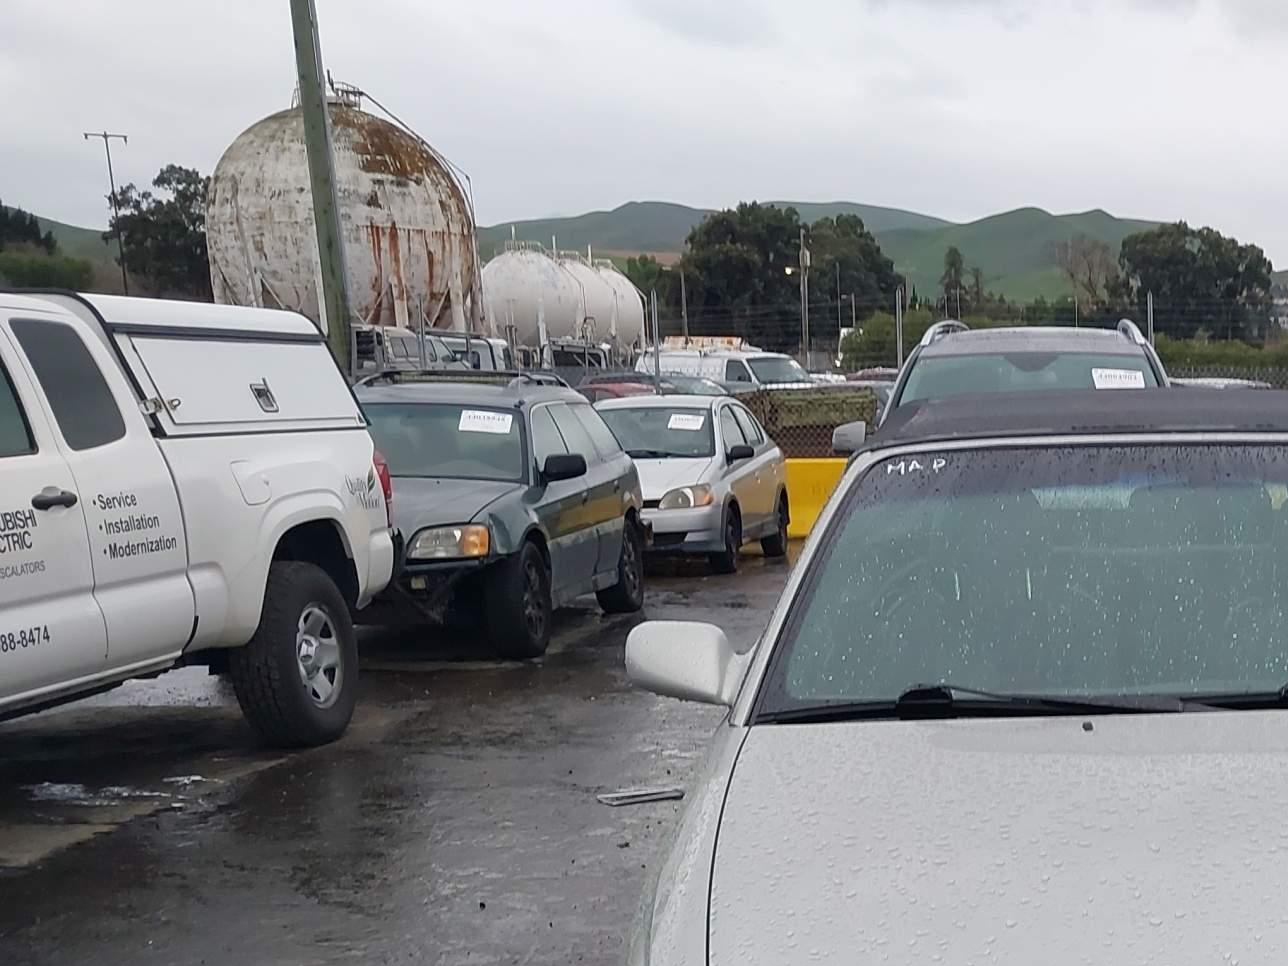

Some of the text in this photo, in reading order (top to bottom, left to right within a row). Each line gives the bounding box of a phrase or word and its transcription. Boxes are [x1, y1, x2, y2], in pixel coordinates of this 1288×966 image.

[97, 491, 137, 510] Service
[104, 513, 160, 535] Installation
[108, 535, 177, 560] Modernization
[0, 624, 50, 653] 88-8474
